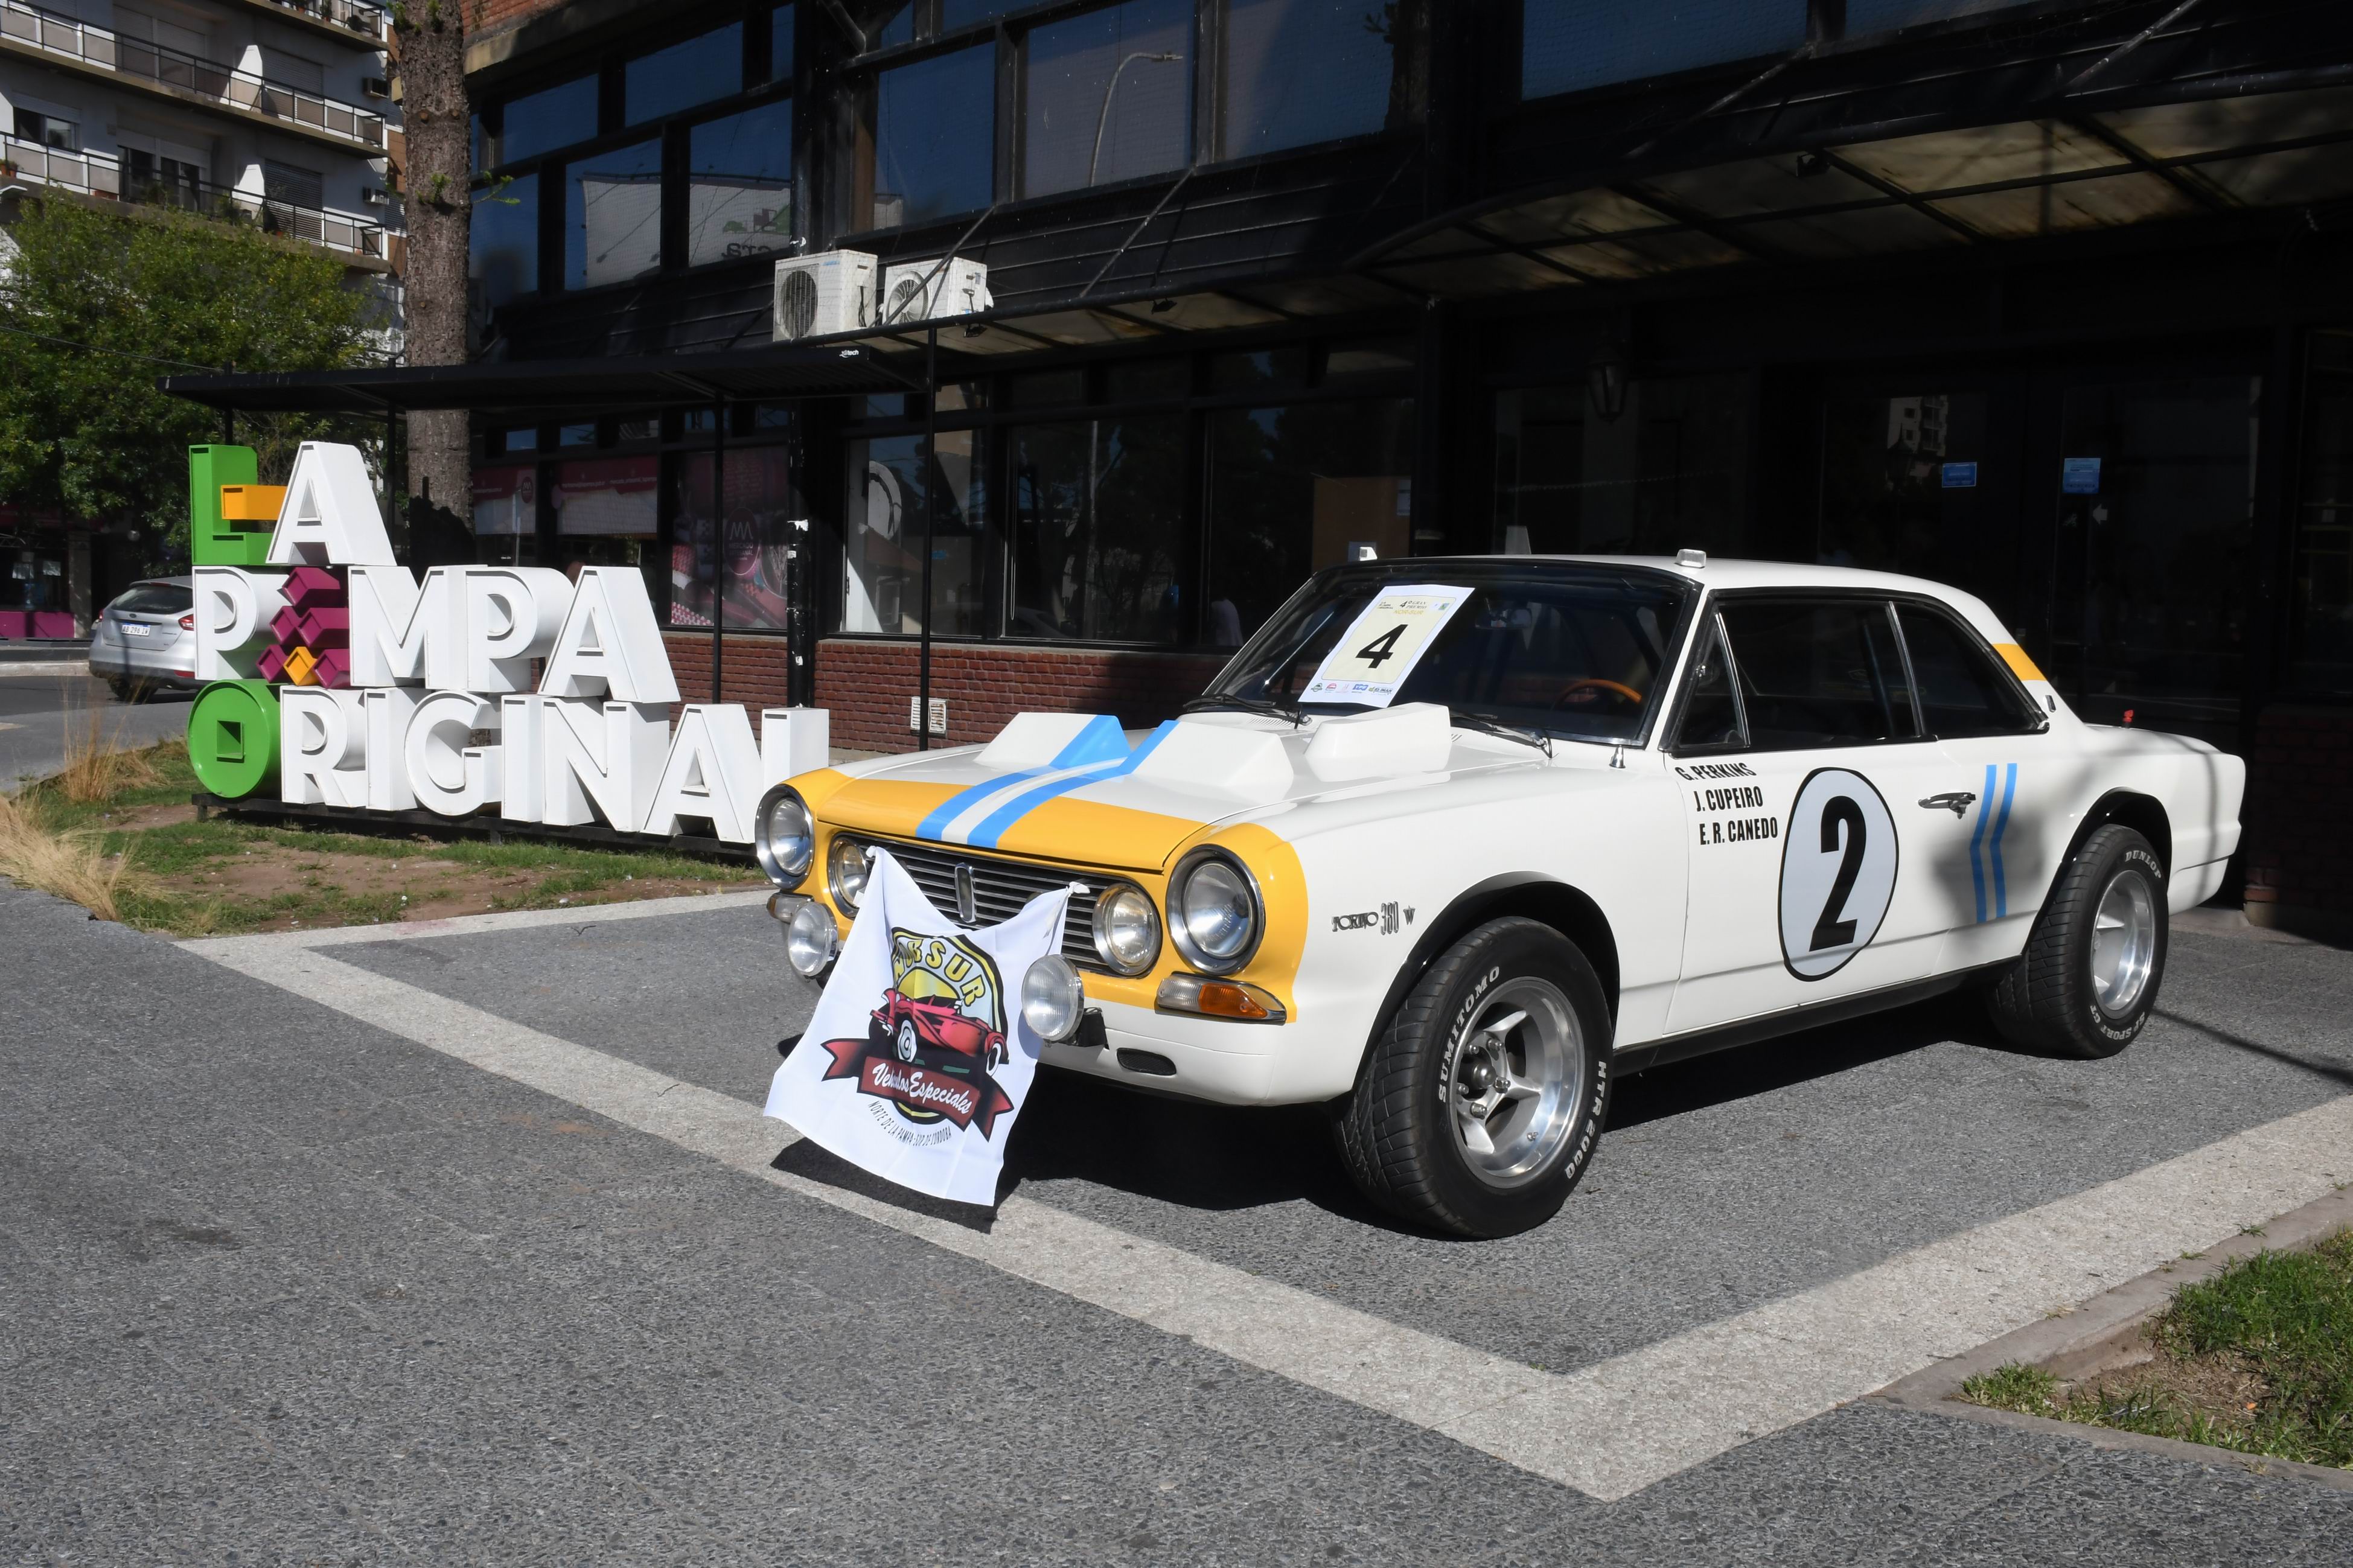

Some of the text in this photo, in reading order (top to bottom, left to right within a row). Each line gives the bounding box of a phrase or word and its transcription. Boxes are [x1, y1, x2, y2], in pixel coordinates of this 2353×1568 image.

[190, 441, 396, 566] LA
[1356, 623, 1409, 669] 4
[1693, 786, 1763, 812] J. CUPEIRO
[1699, 817, 1778, 846] E. R. CANEDO
[1809, 795, 1866, 952] 2
[2125, 850, 2162, 878] DUNLOP
[1438, 966, 1499, 1103] SUMITOMO
[2100, 1025, 2132, 1040] SPORT
[910, 1071, 972, 1114] Especiales
[868, 1100, 889, 1121] NORTE
[880, 1117, 895, 1130] DE
[1564, 1061, 1606, 1179] HTR 2000
[887, 1123, 899, 1136] LA
